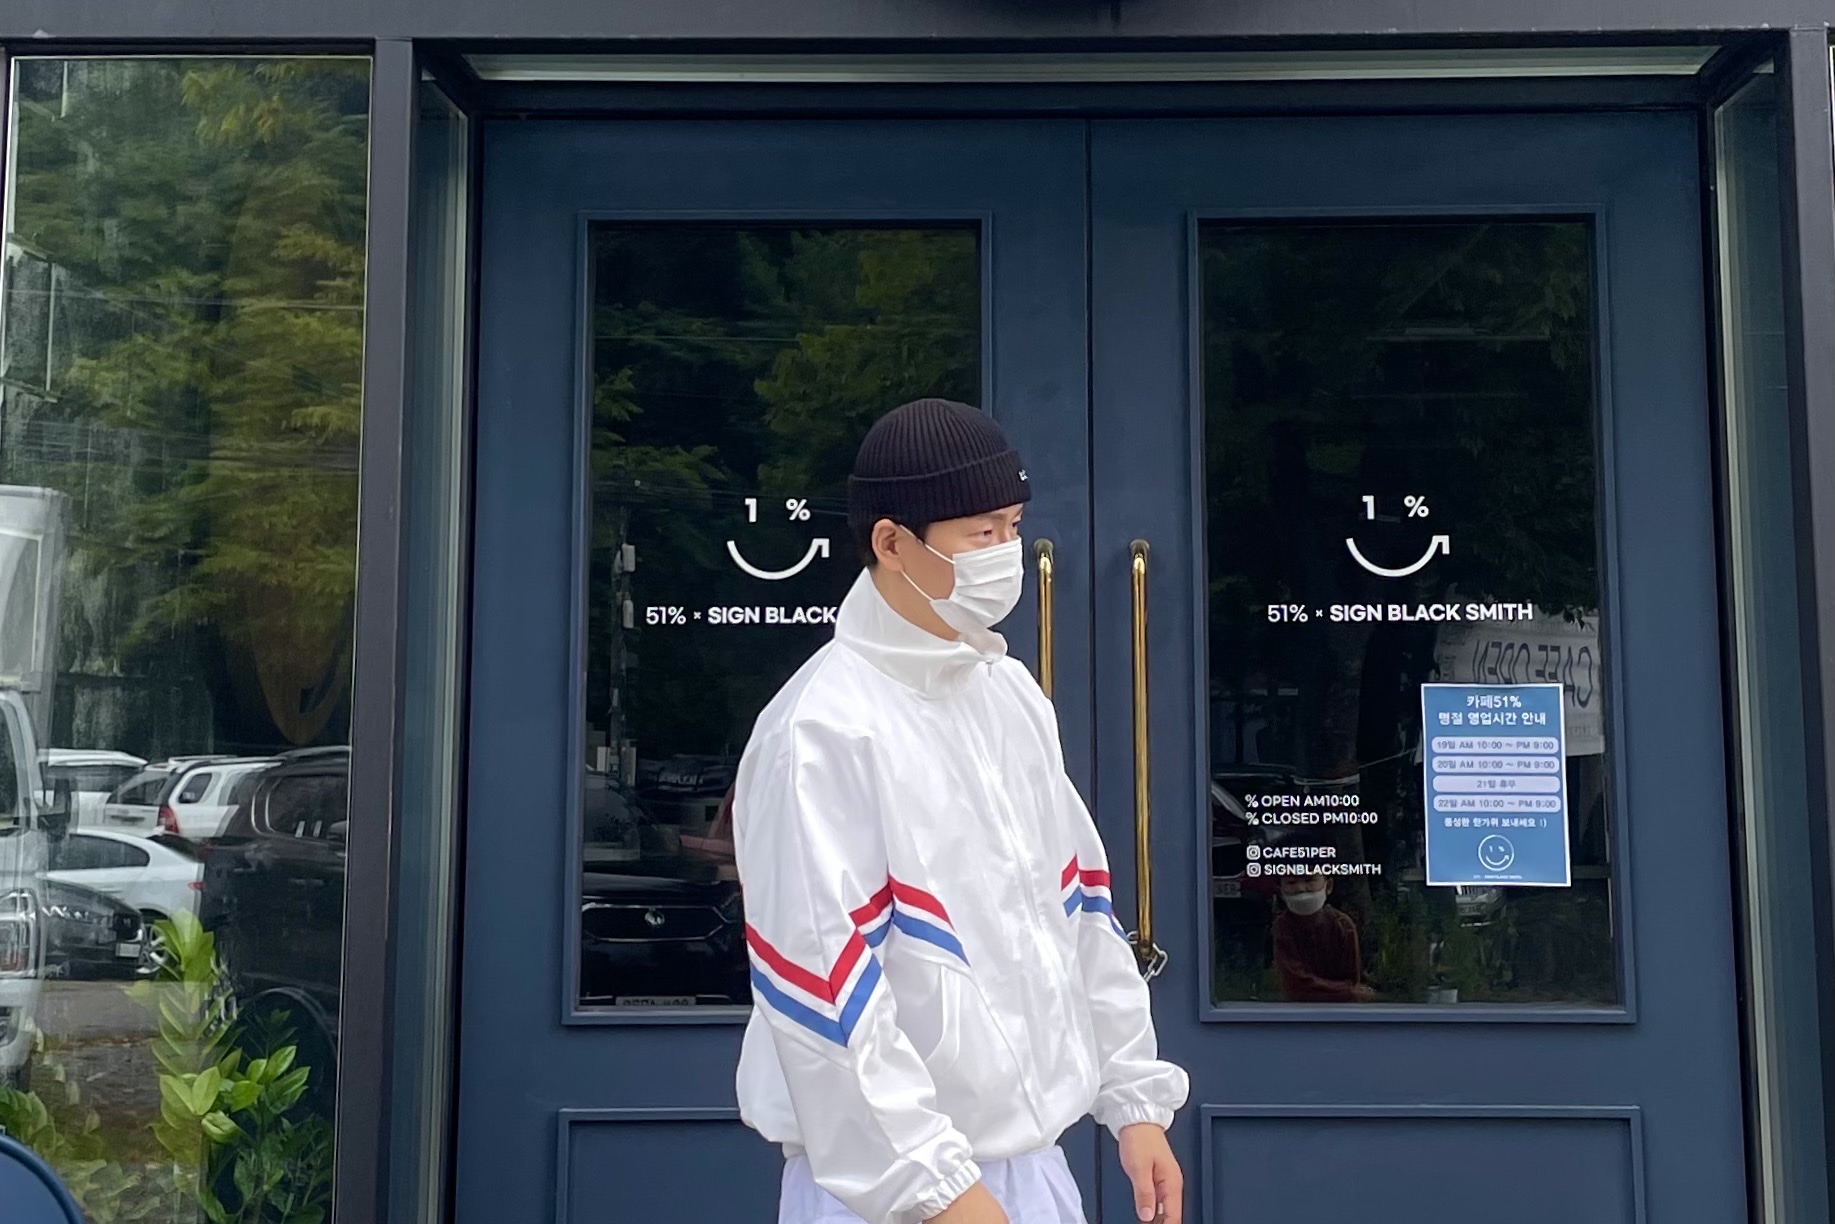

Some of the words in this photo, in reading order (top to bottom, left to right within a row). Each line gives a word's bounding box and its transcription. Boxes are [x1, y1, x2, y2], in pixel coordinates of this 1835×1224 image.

[745, 498, 757, 522] 1
[785, 498, 811, 521] %
[1362, 495, 1375, 520] 1
[1403, 495, 1429, 517] %
[646, 606, 686, 625] 51%
[707, 606, 760, 624] SIGN
[765, 606, 838, 624] BLACK
[1267, 604, 1309, 623] 51%
[1329, 604, 1382, 622] SIGN
[1388, 603, 1461, 621] BLACK
[1465, 602, 1533, 621] SMITH
[1466, 694, 1522, 708] 카페51%
[1468, 712, 1517, 725] 영업시간
[1521, 712, 1546, 725] 안내
[1459, 741, 1473, 749] AM
[1477, 741, 1502, 750] 10:00
[1516, 741, 1530, 749] PM
[1460, 761, 1474, 769] AM
[1478, 761, 1503, 769] 10:00
[1517, 761, 1531, 769] PM
[1261, 795, 1300, 807] OPEN
[1303, 794, 1360, 807] AM10:00
[1461, 800, 1475, 808] AM
[1479, 800, 1504, 808] 10:00
[1518, 800, 1532, 808] PM
[1261, 812, 1319, 824] CLOSED
[1323, 812, 1378, 824] PM10:00
[1262, 847, 1336, 858] CAFE51PER
[1264, 864, 1382, 875] SIGNBLACKSMITH
